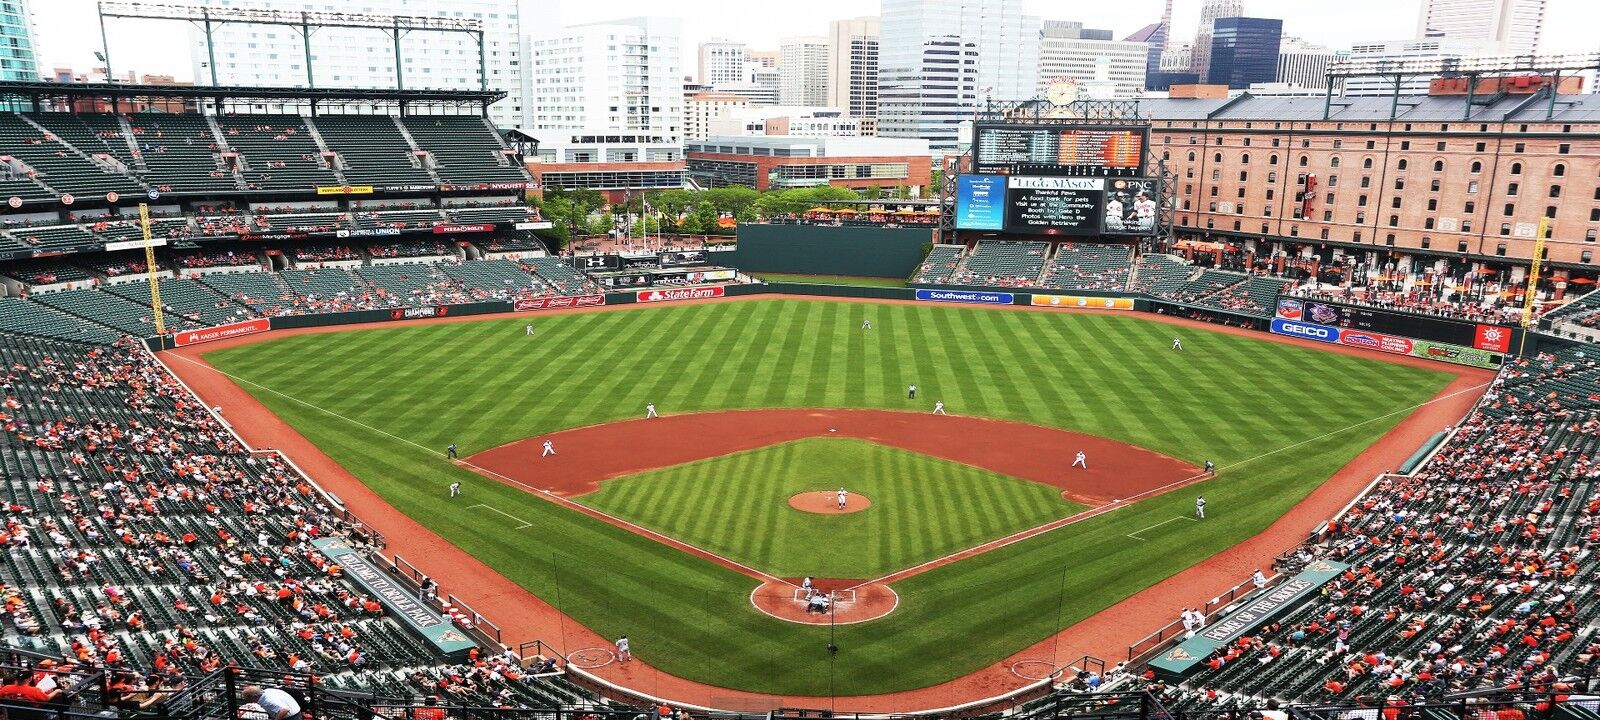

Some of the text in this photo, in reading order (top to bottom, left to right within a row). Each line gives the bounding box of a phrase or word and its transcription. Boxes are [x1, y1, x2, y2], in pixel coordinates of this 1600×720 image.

[1018, 179, 1094, 189] LEGG MASON
[1127, 181, 1152, 189] PNC
[200, 332, 219, 340] KAISER
[1282, 323, 1328, 338] GEICO
[1344, 335, 1380, 347] HORIZON
[370, 577, 389, 589] TO
[406, 607, 438, 628] PARK
[1205, 620, 1245, 641] HOME
[1236, 611, 1257, 622] OF
[1248, 600, 1278, 614] THE
